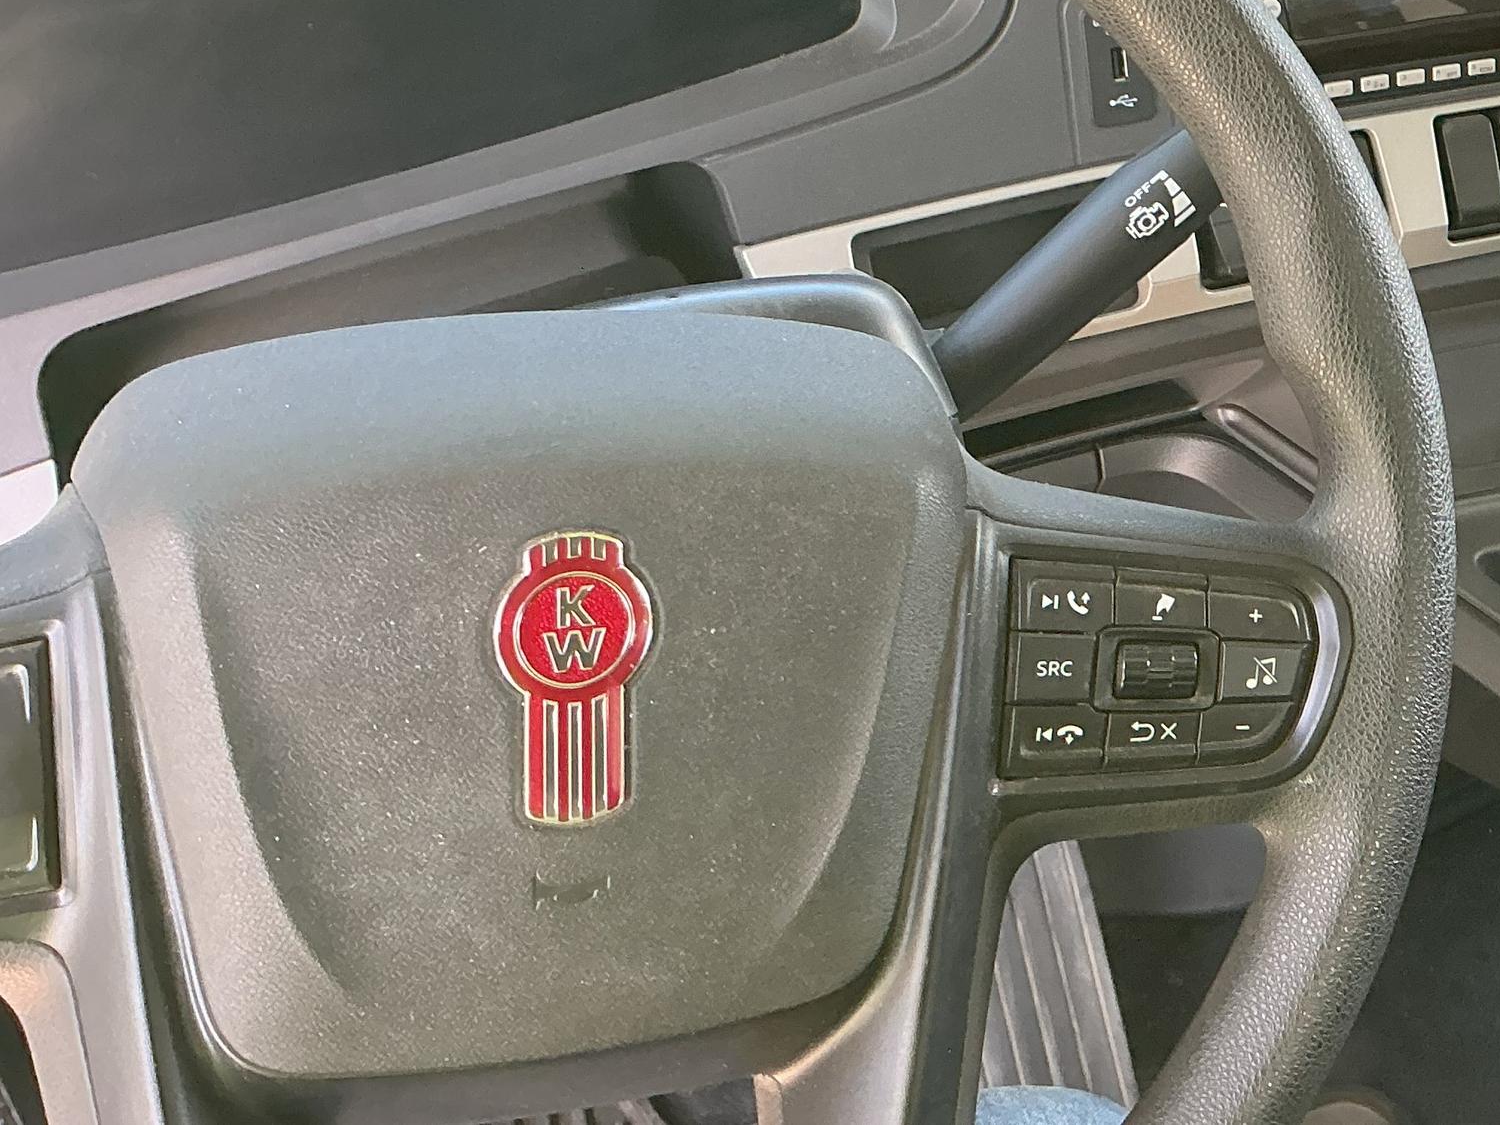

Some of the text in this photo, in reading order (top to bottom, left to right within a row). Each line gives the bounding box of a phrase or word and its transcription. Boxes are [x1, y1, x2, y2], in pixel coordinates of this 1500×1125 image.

[1124, 181, 1151, 207] OFF
[556, 584, 596, 629] K
[543, 628, 606, 673] W
[1036, 660, 1074, 677] SRC
